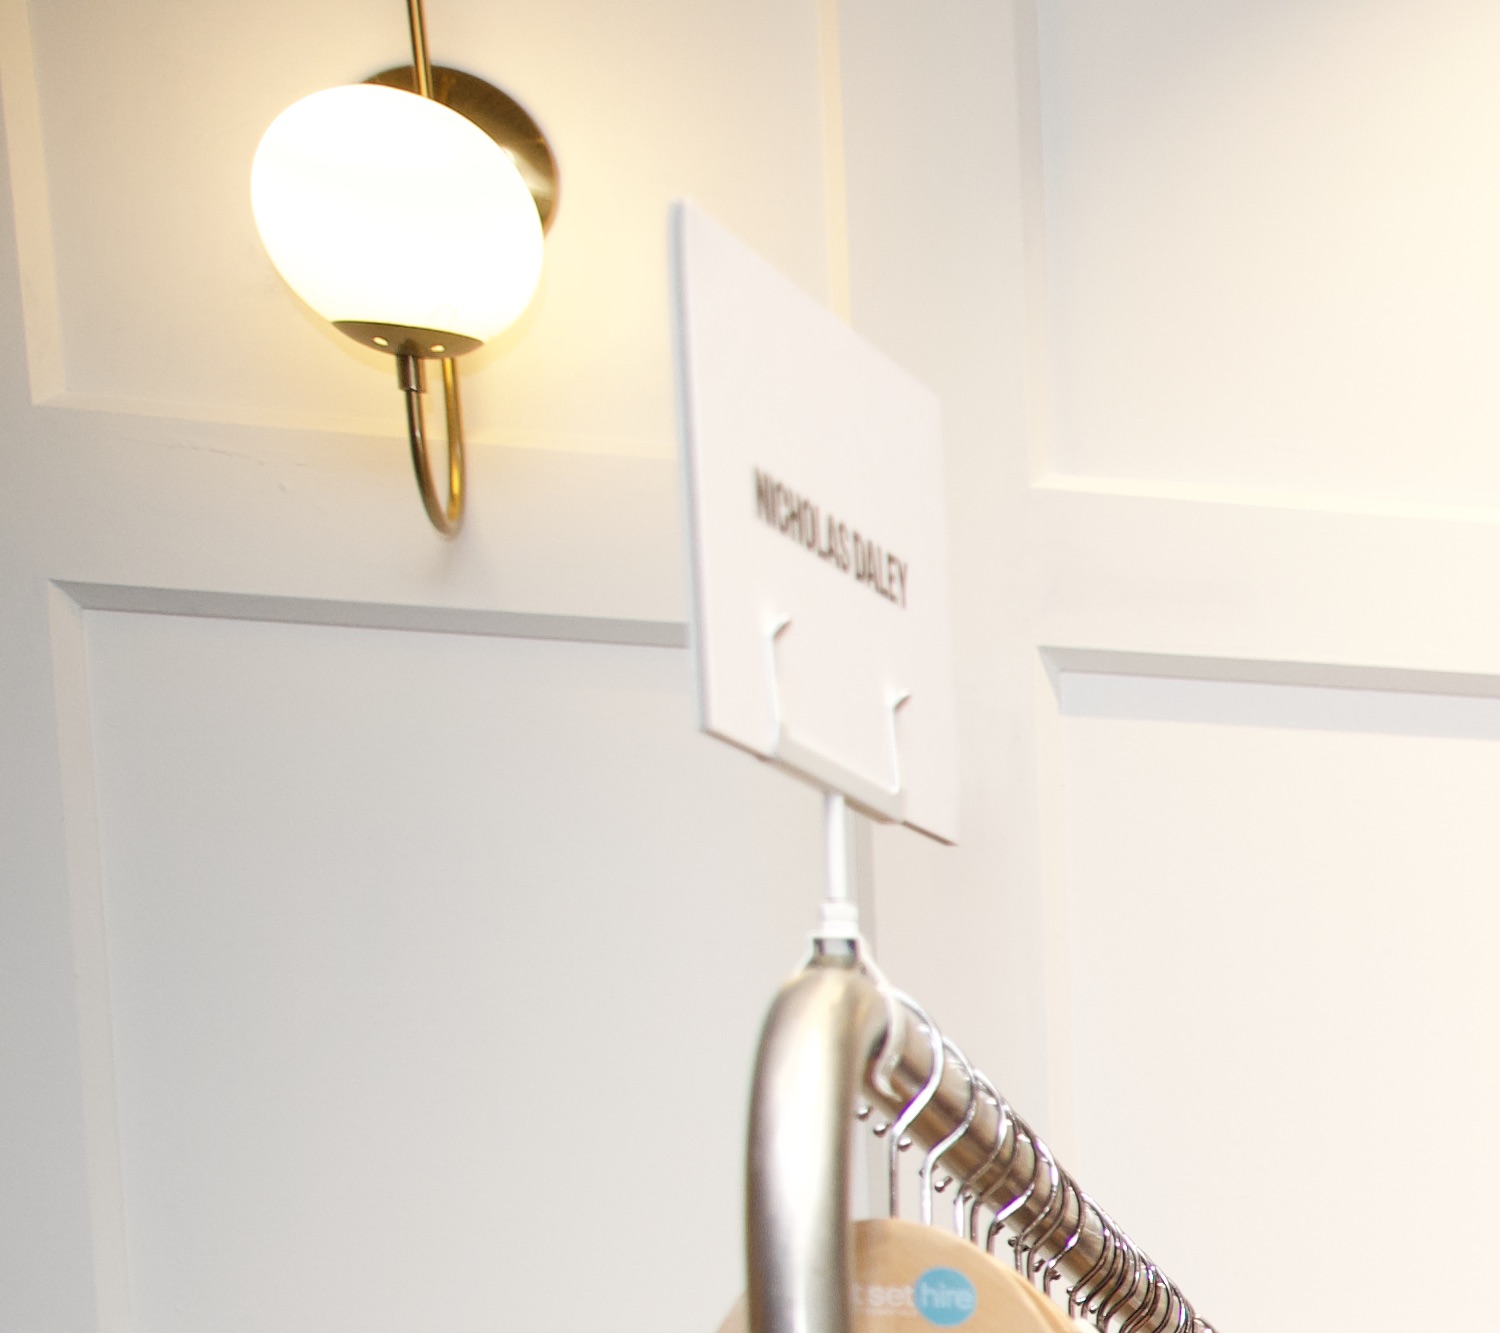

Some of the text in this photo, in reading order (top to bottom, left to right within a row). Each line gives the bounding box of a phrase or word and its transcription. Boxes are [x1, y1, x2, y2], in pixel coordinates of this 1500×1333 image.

[754, 465, 908, 609] NICHOLAS DALEY
[868, 1285, 914, 1307] set
[920, 1281, 976, 1310] hire
